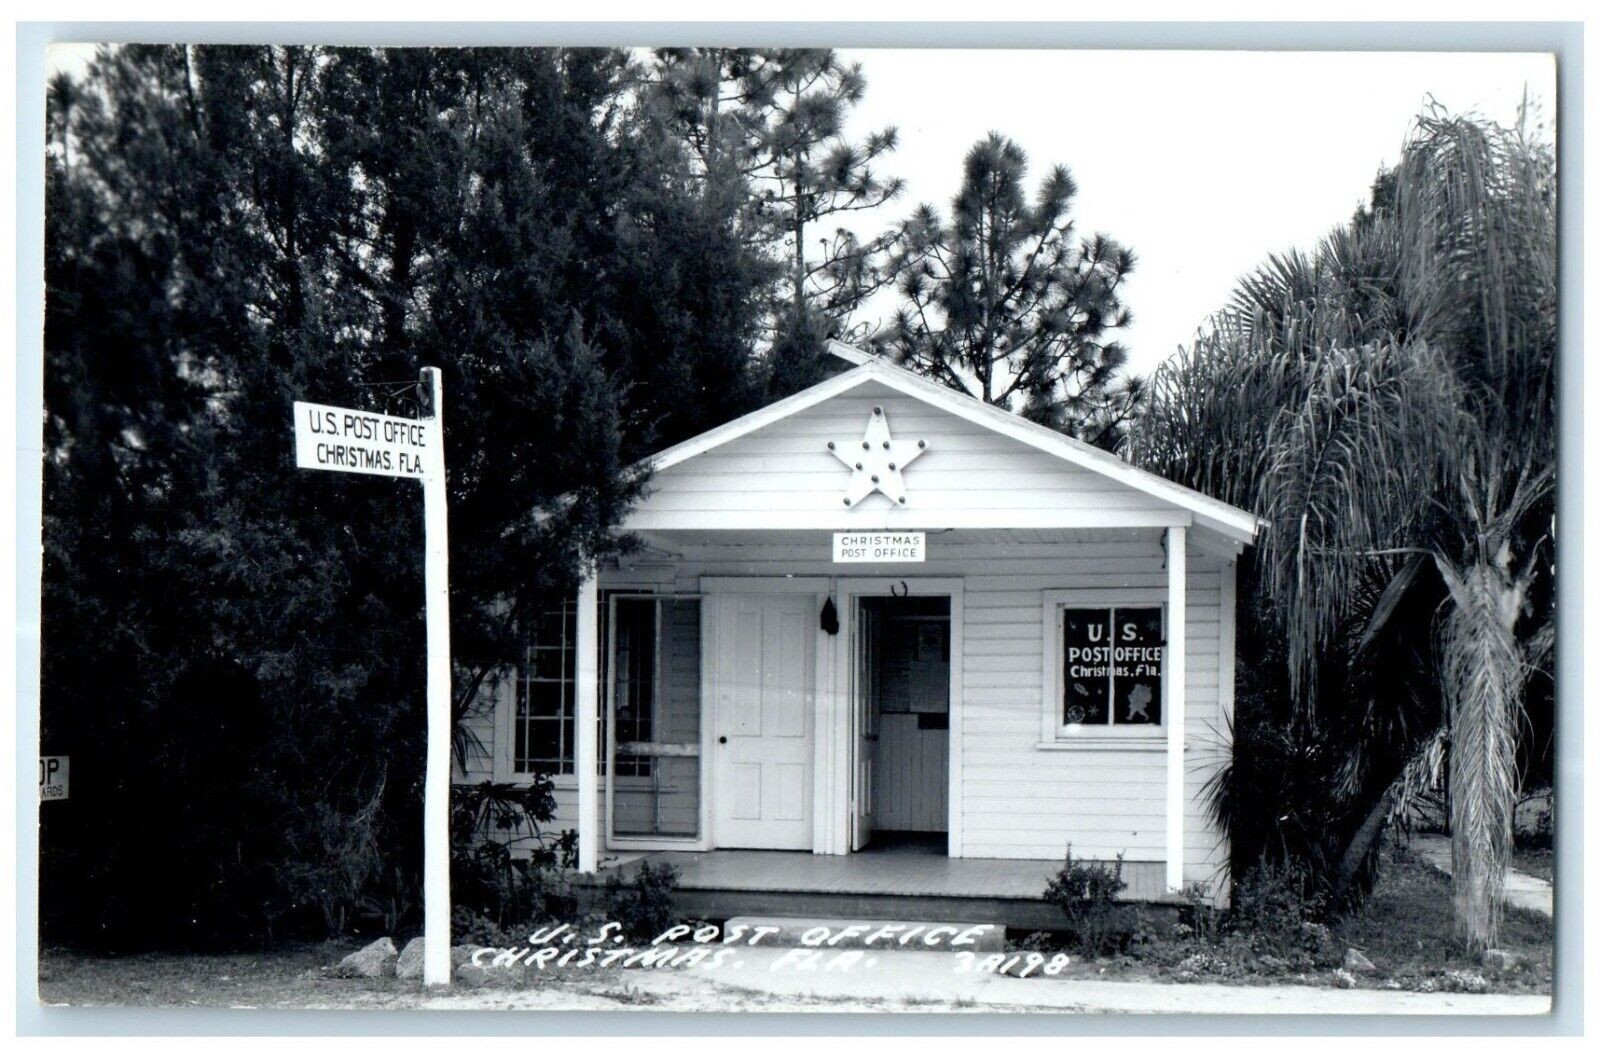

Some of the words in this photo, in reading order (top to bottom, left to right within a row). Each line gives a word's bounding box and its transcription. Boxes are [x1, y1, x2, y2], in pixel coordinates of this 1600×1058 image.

[309, 409, 340, 436] U.S.
[344, 414, 380, 441] POST
[384, 421, 426, 447] OFFICE
[399, 453, 425, 473] FLA.
[841, 536, 920, 546] CHRISTMAS
[841, 548, 866, 558] POST
[874, 548, 917, 558] OFFICE
[1068, 647, 1111, 663] POST
[1114, 647, 1161, 662] OFFICE
